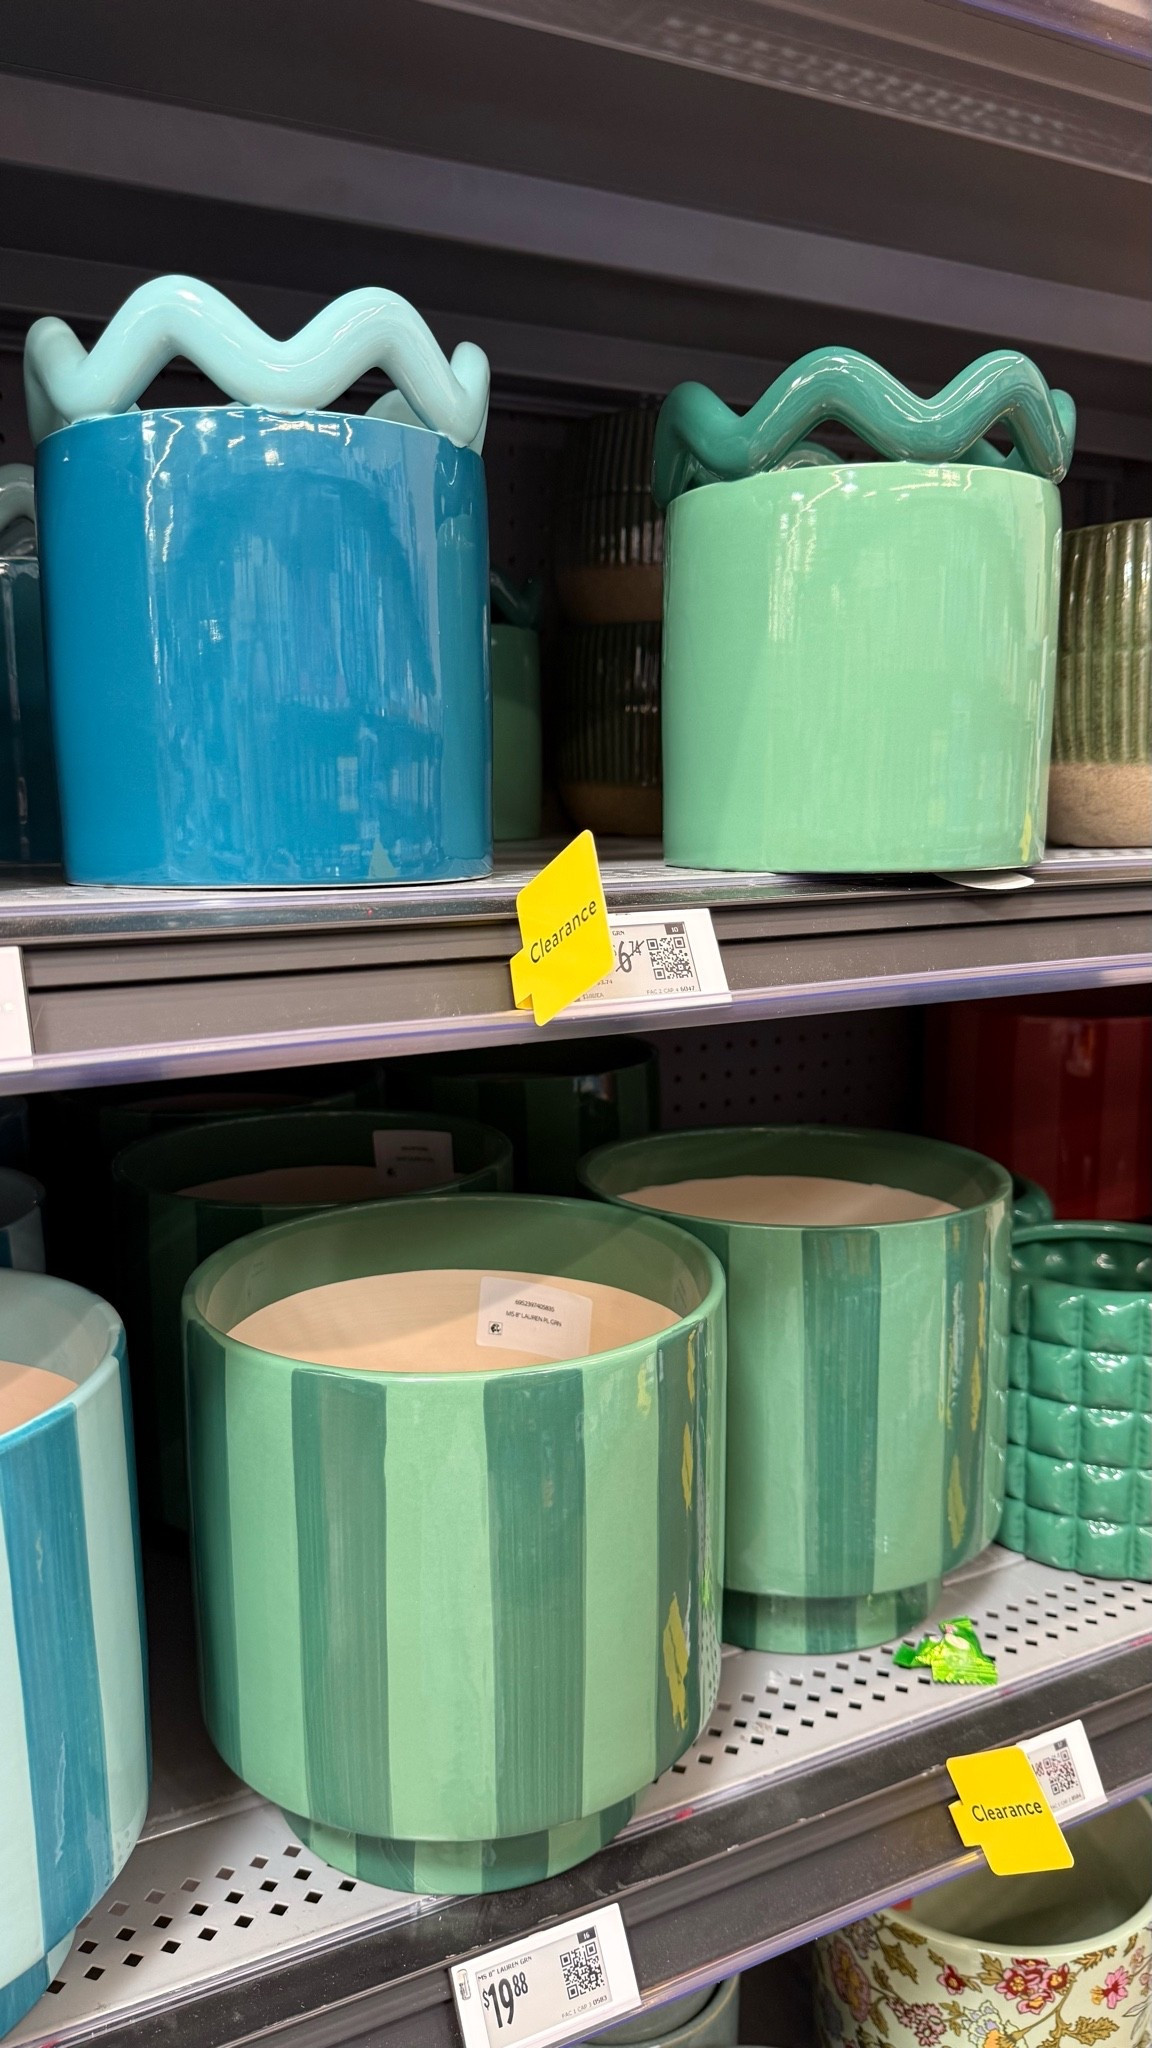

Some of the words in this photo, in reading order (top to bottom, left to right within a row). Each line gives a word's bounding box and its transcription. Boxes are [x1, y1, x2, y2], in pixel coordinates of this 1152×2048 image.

[530, 900, 597, 963] Clearance
[521, 1313, 543, 1322] LAUREN
[972, 1802, 1043, 1822] Clearance
[496, 1960, 519, 1974] LAUREN
[520, 1956, 532, 1965] GRN
